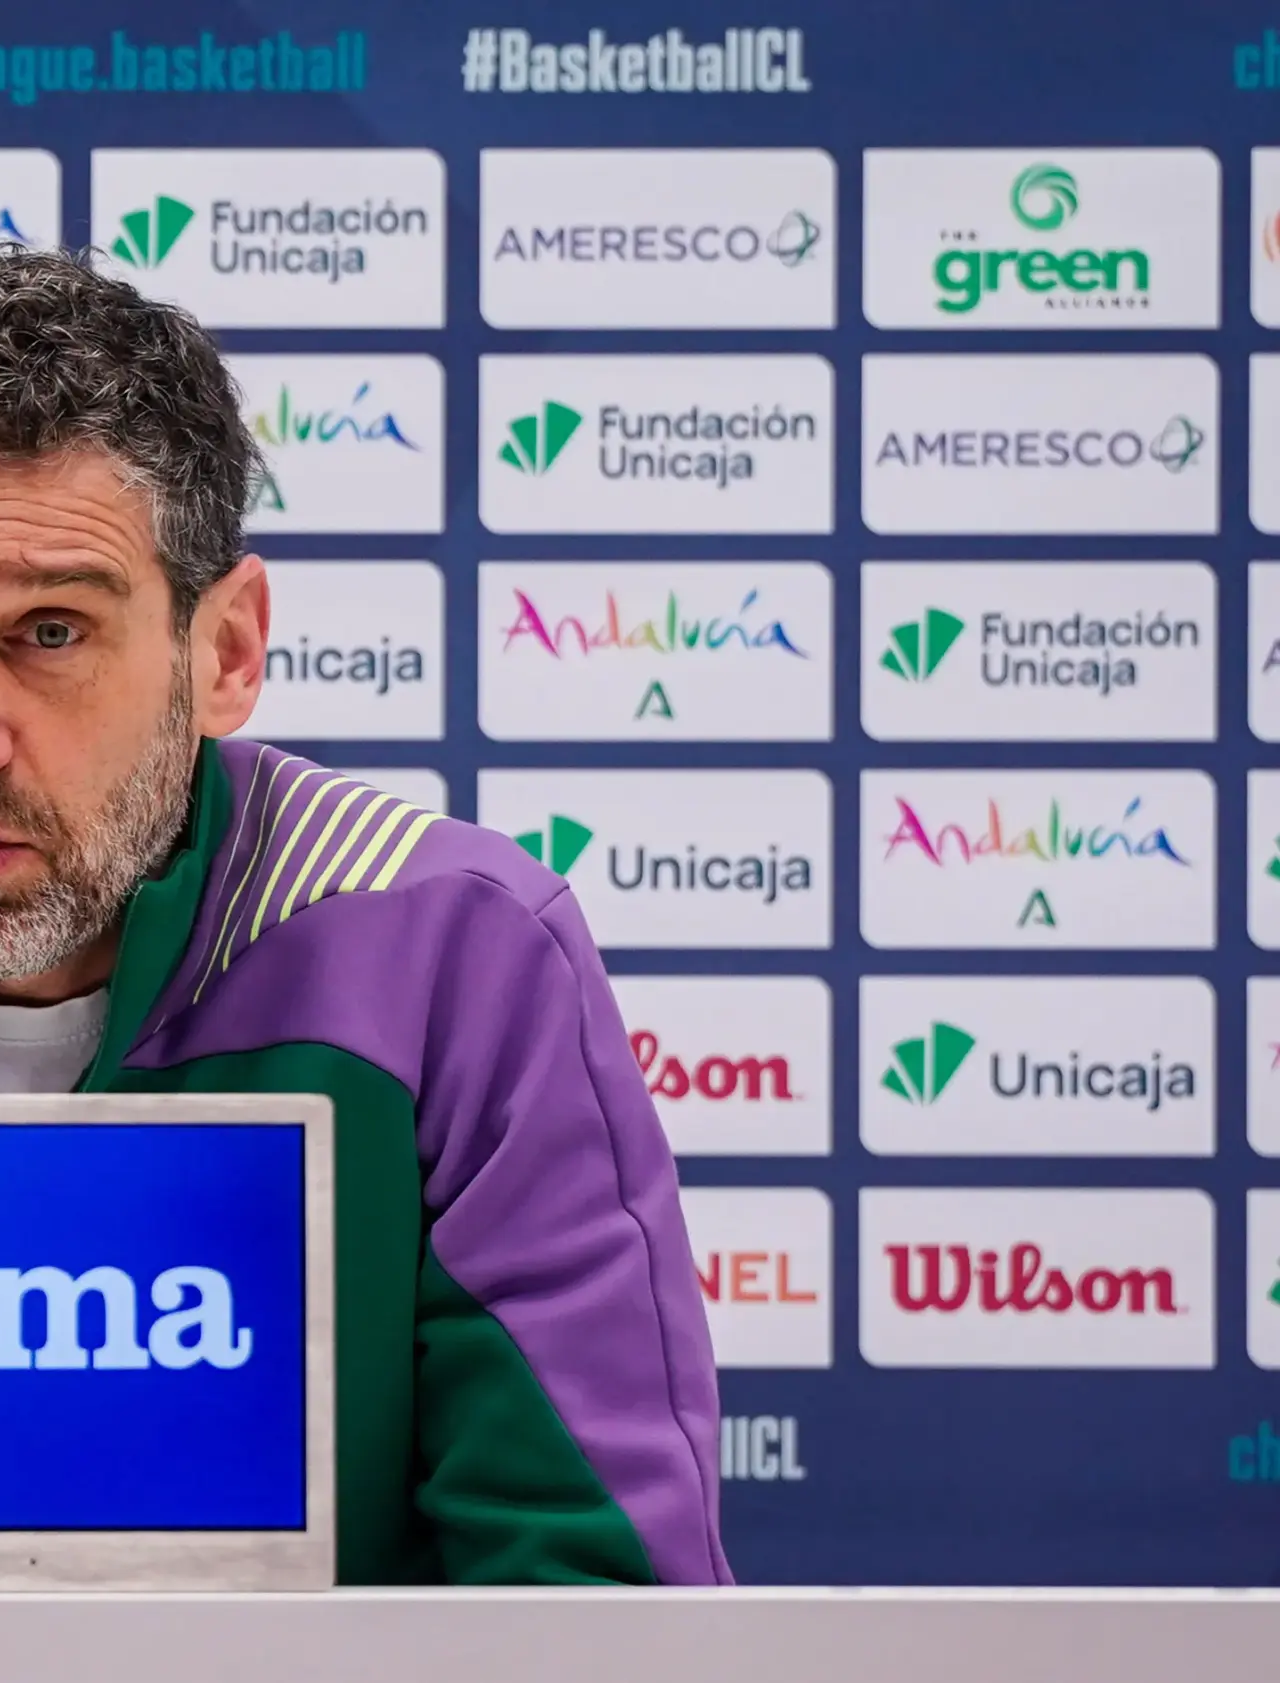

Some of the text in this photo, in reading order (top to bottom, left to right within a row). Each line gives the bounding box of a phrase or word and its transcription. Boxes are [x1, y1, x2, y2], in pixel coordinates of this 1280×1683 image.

[461, 28, 811, 92] #BasketballCL
[211, 200, 427, 235] Fundación
[211, 239, 365, 284] Unicaja
[495, 226, 760, 262] AMERESCO
[934, 249, 1149, 314] green
[600, 405, 816, 440] Fundación
[599, 444, 754, 489] Unicaja
[876, 430, 1144, 467] AMERESCO
[505, 589, 807, 659] Andalucía
[982, 611, 1199, 647] Fundación
[981, 650, 1137, 697] Unicaja
[886, 797, 1189, 866] Andalucía
[609, 845, 811, 904] Unicaja
[991, 1052, 1195, 1112] Unicaja
[885, 1242, 1177, 1314] Wilson
